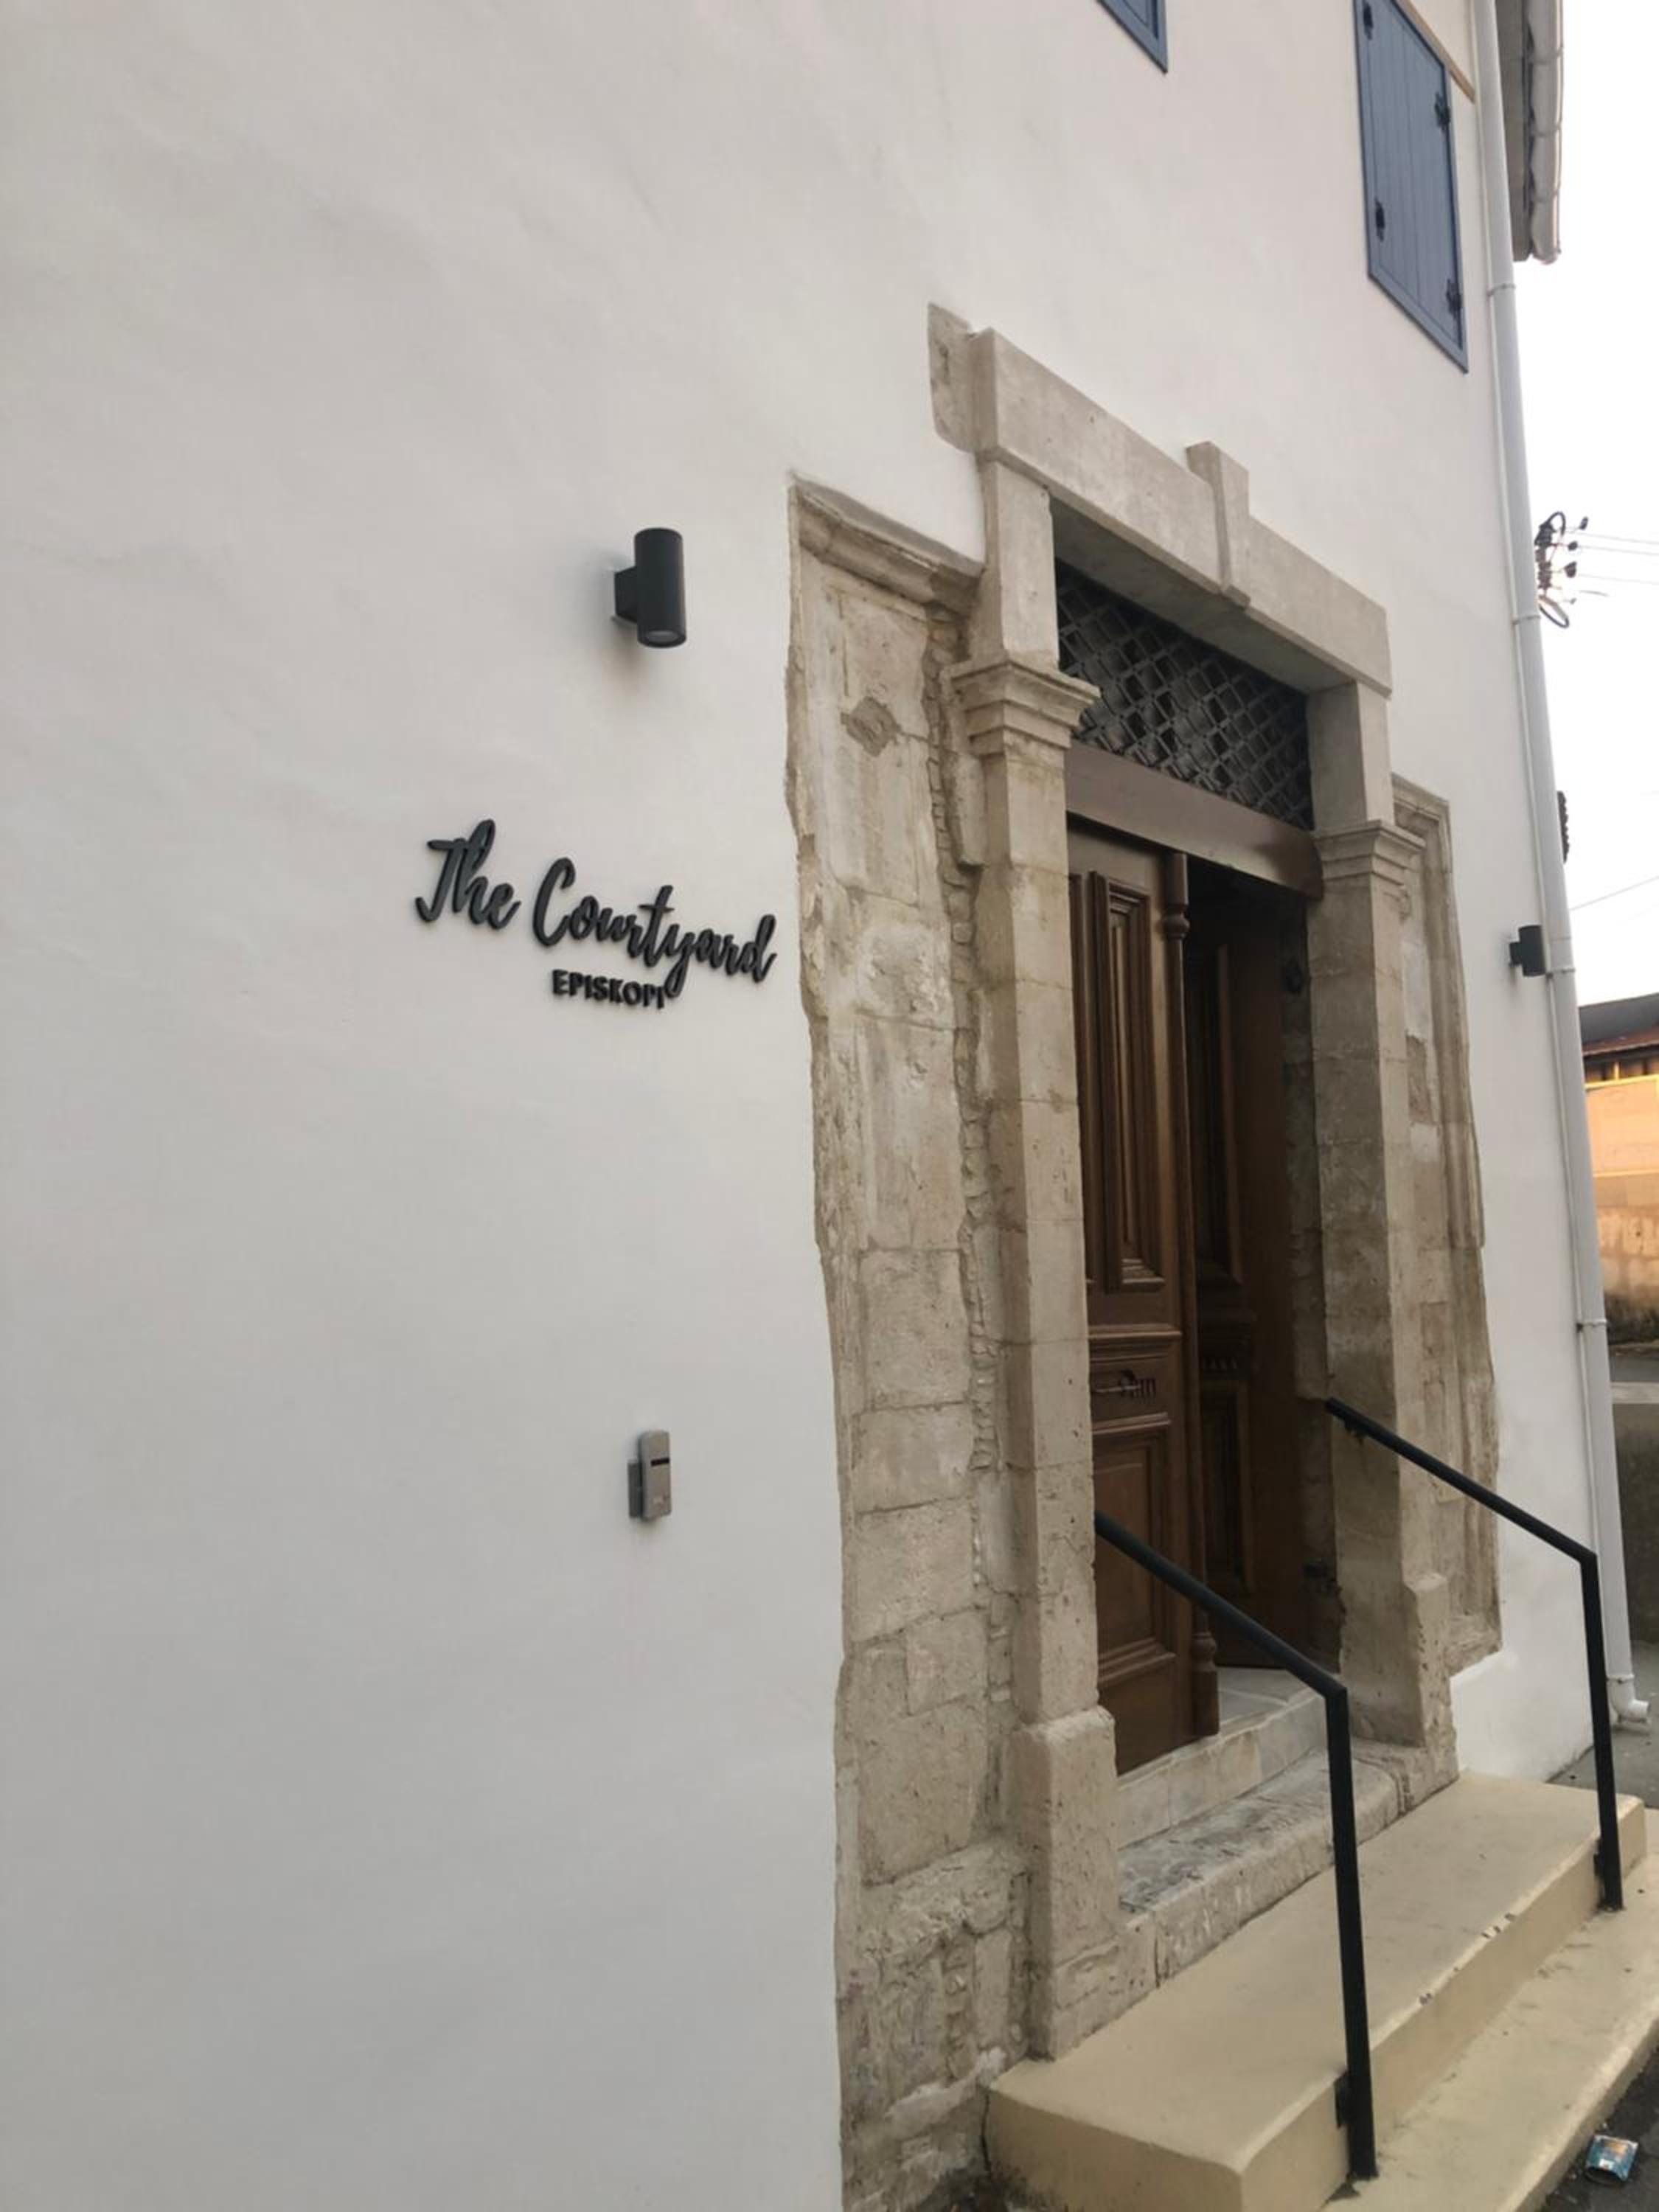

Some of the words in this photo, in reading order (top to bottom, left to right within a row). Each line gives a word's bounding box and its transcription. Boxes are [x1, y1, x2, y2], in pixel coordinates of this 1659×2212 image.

[415, 819, 521, 931] The
[532, 858, 777, 998] Courtyard
[552, 969, 664, 1009] EPISKOPI
